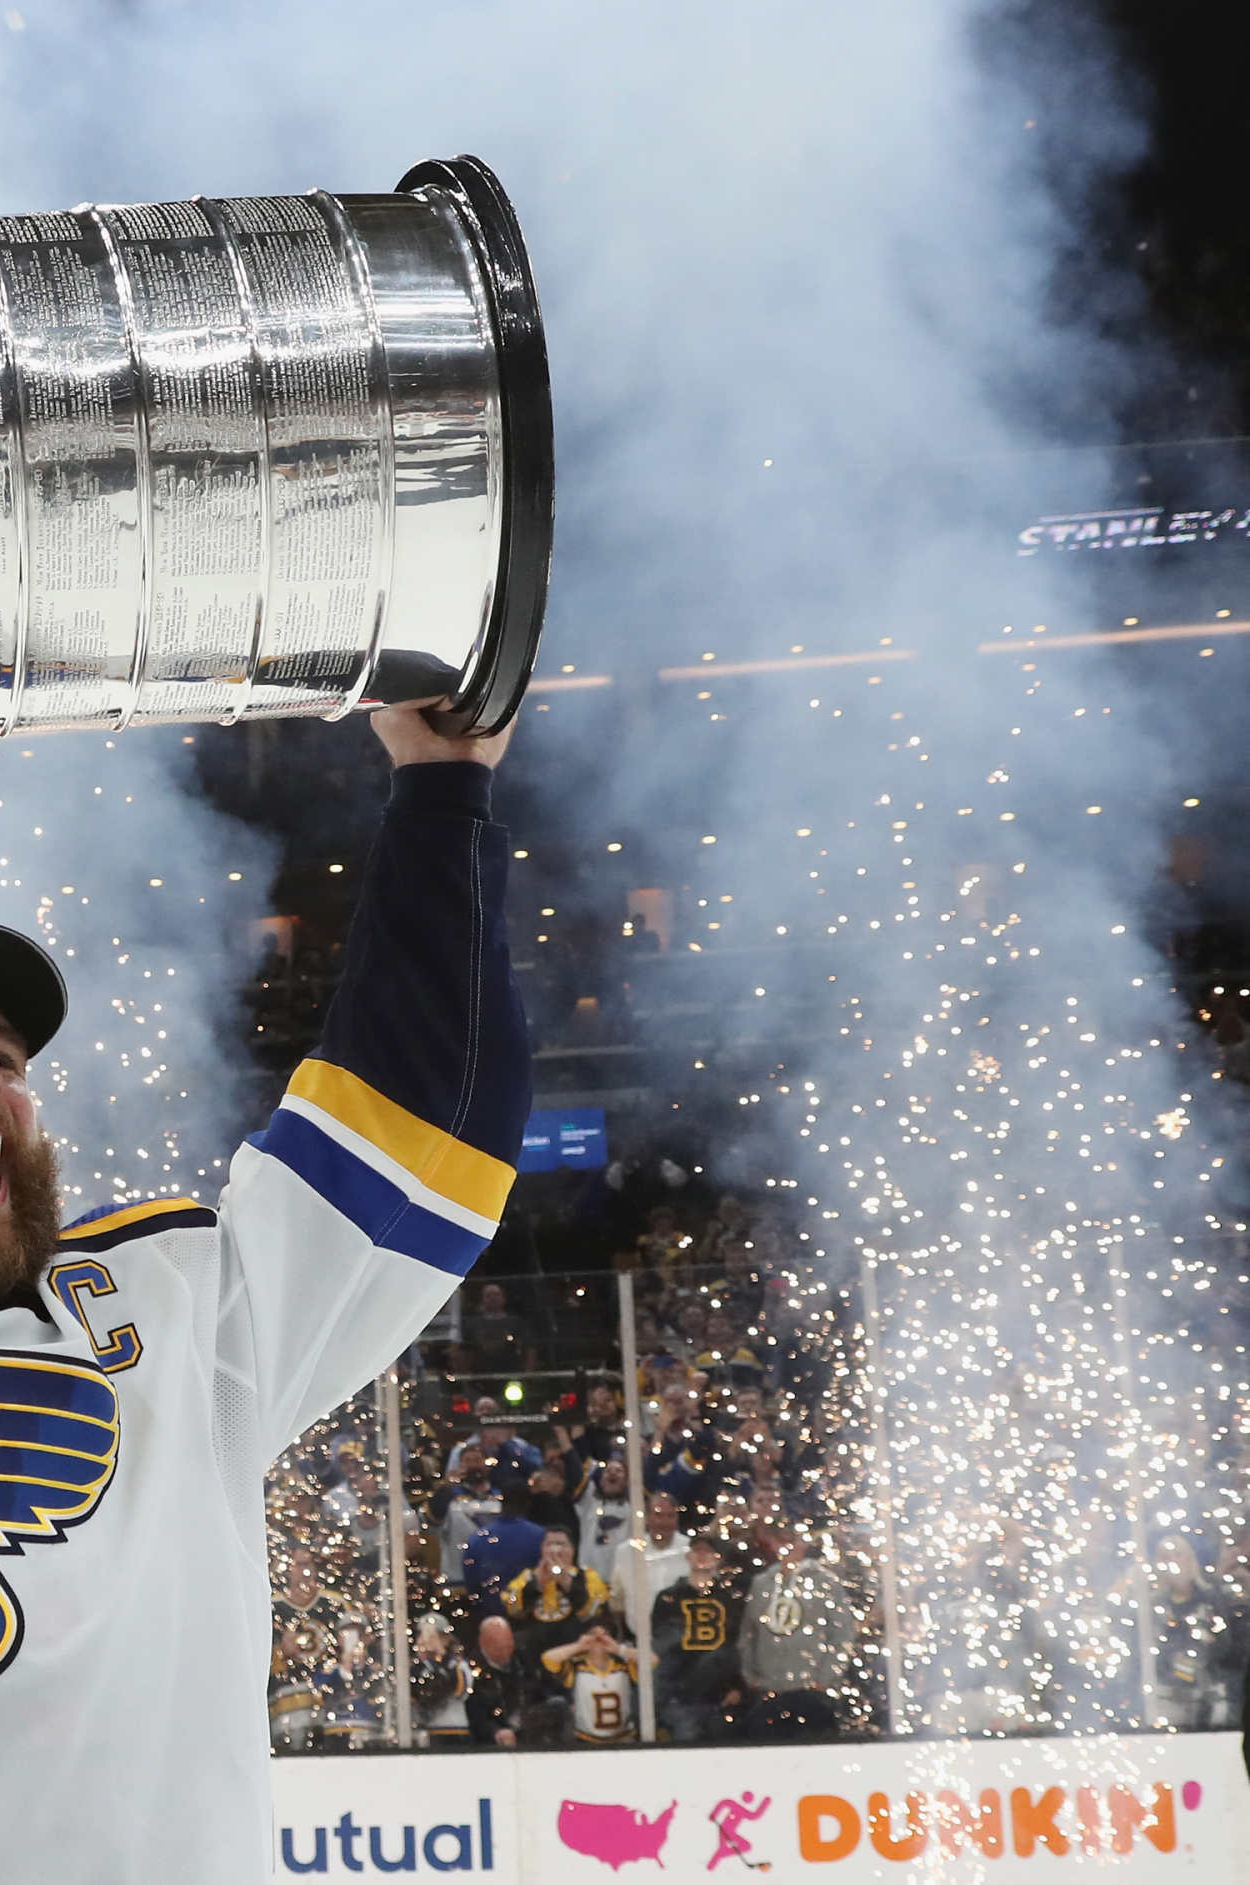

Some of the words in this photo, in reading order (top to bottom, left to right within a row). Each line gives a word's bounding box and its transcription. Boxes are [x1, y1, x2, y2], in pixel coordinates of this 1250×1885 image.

[47, 1258, 144, 1374] C
[680, 1598, 727, 1651] B
[591, 1689, 622, 1729] B
[273, 1798, 494, 1875] utual
[797, 1780, 1202, 1862] DUNKIN'
